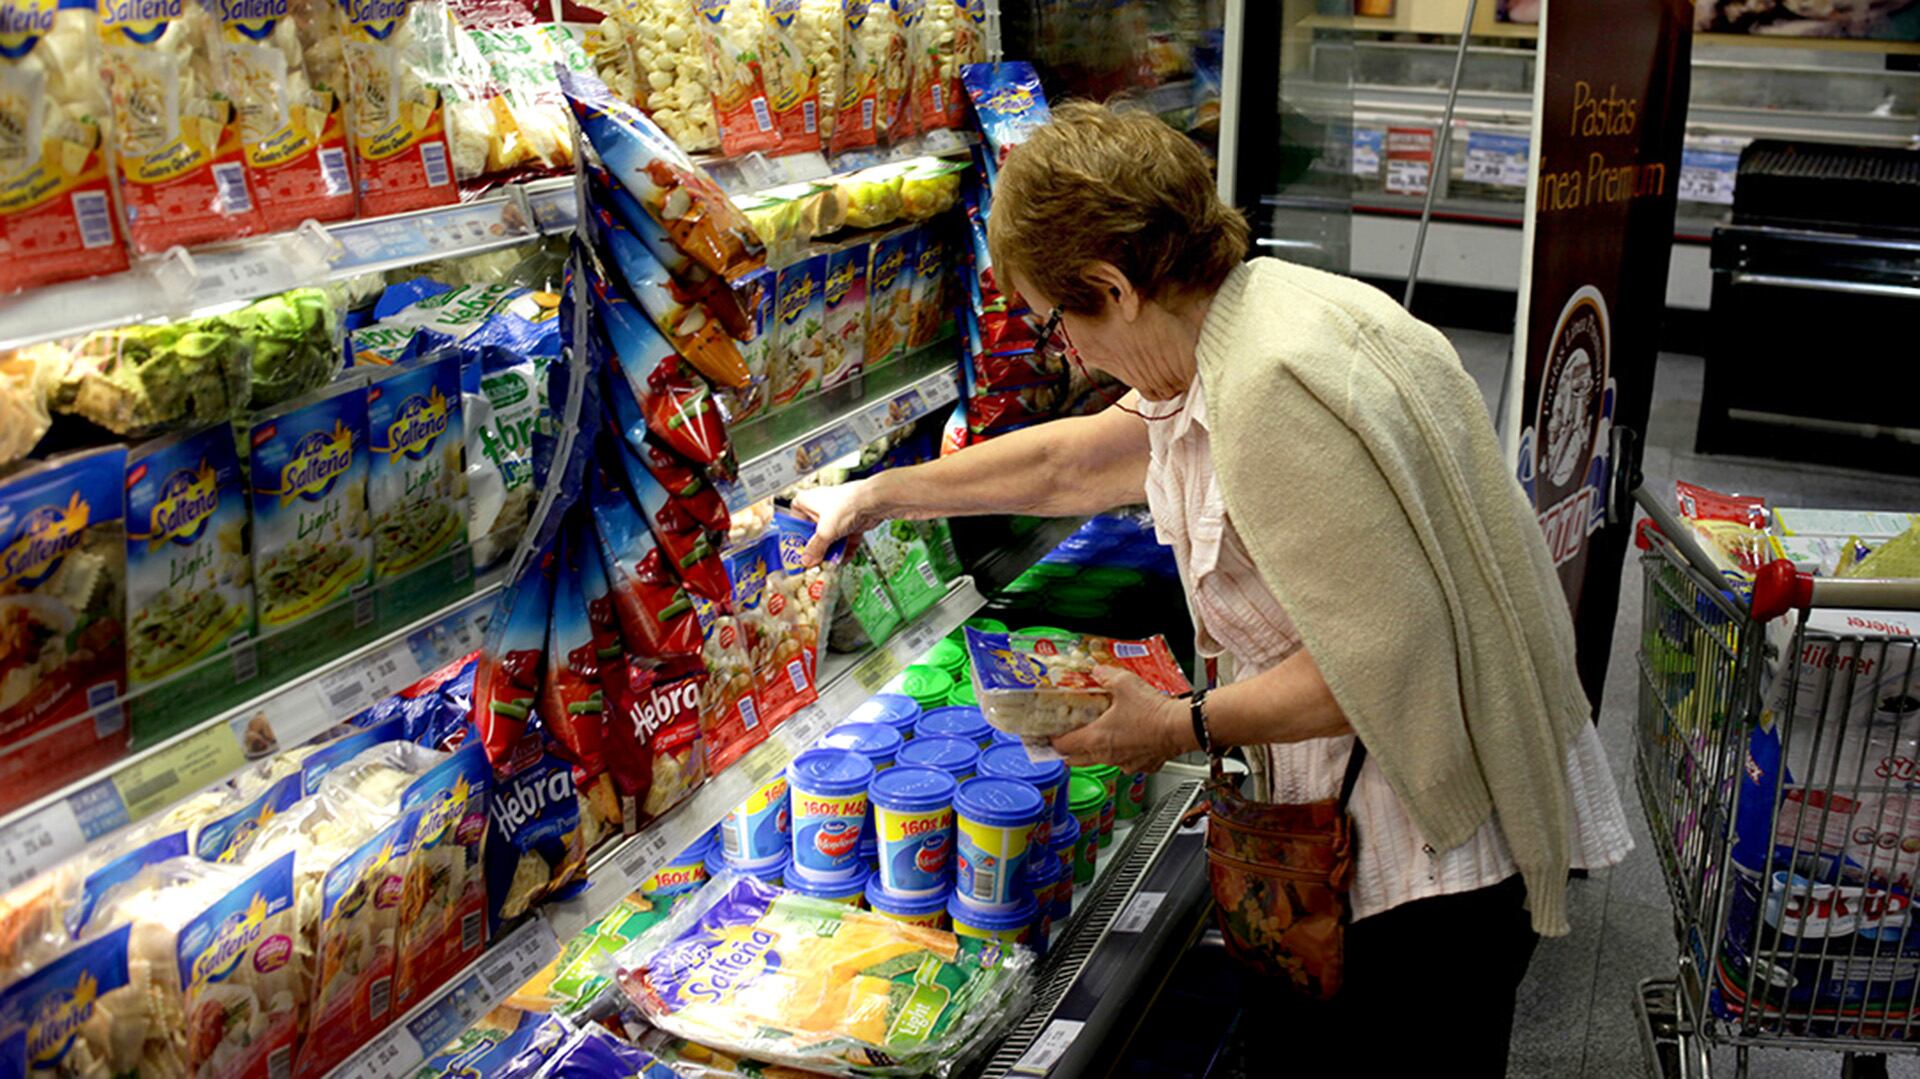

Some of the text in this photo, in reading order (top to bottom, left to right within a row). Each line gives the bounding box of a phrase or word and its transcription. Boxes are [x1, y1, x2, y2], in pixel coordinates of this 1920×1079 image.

[1571, 79, 1638, 137] Pastas
[1536, 148, 1666, 212] ínea Premium
[391, 412, 446, 453] Salteña
[284, 449, 350, 496] Salteña
[405, 459, 442, 500] Light
[151, 488, 217, 540] Salteña
[297, 498, 341, 542] Light
[0, 527, 82, 583] Salteña
[170, 543, 214, 591] Light
[629, 682, 701, 746] Hebra
[192, 921, 262, 986] Salteña
[688, 929, 773, 1004] Salteña
[28, 1000, 93, 1060] alteña
[897, 1002, 932, 1036] Light
